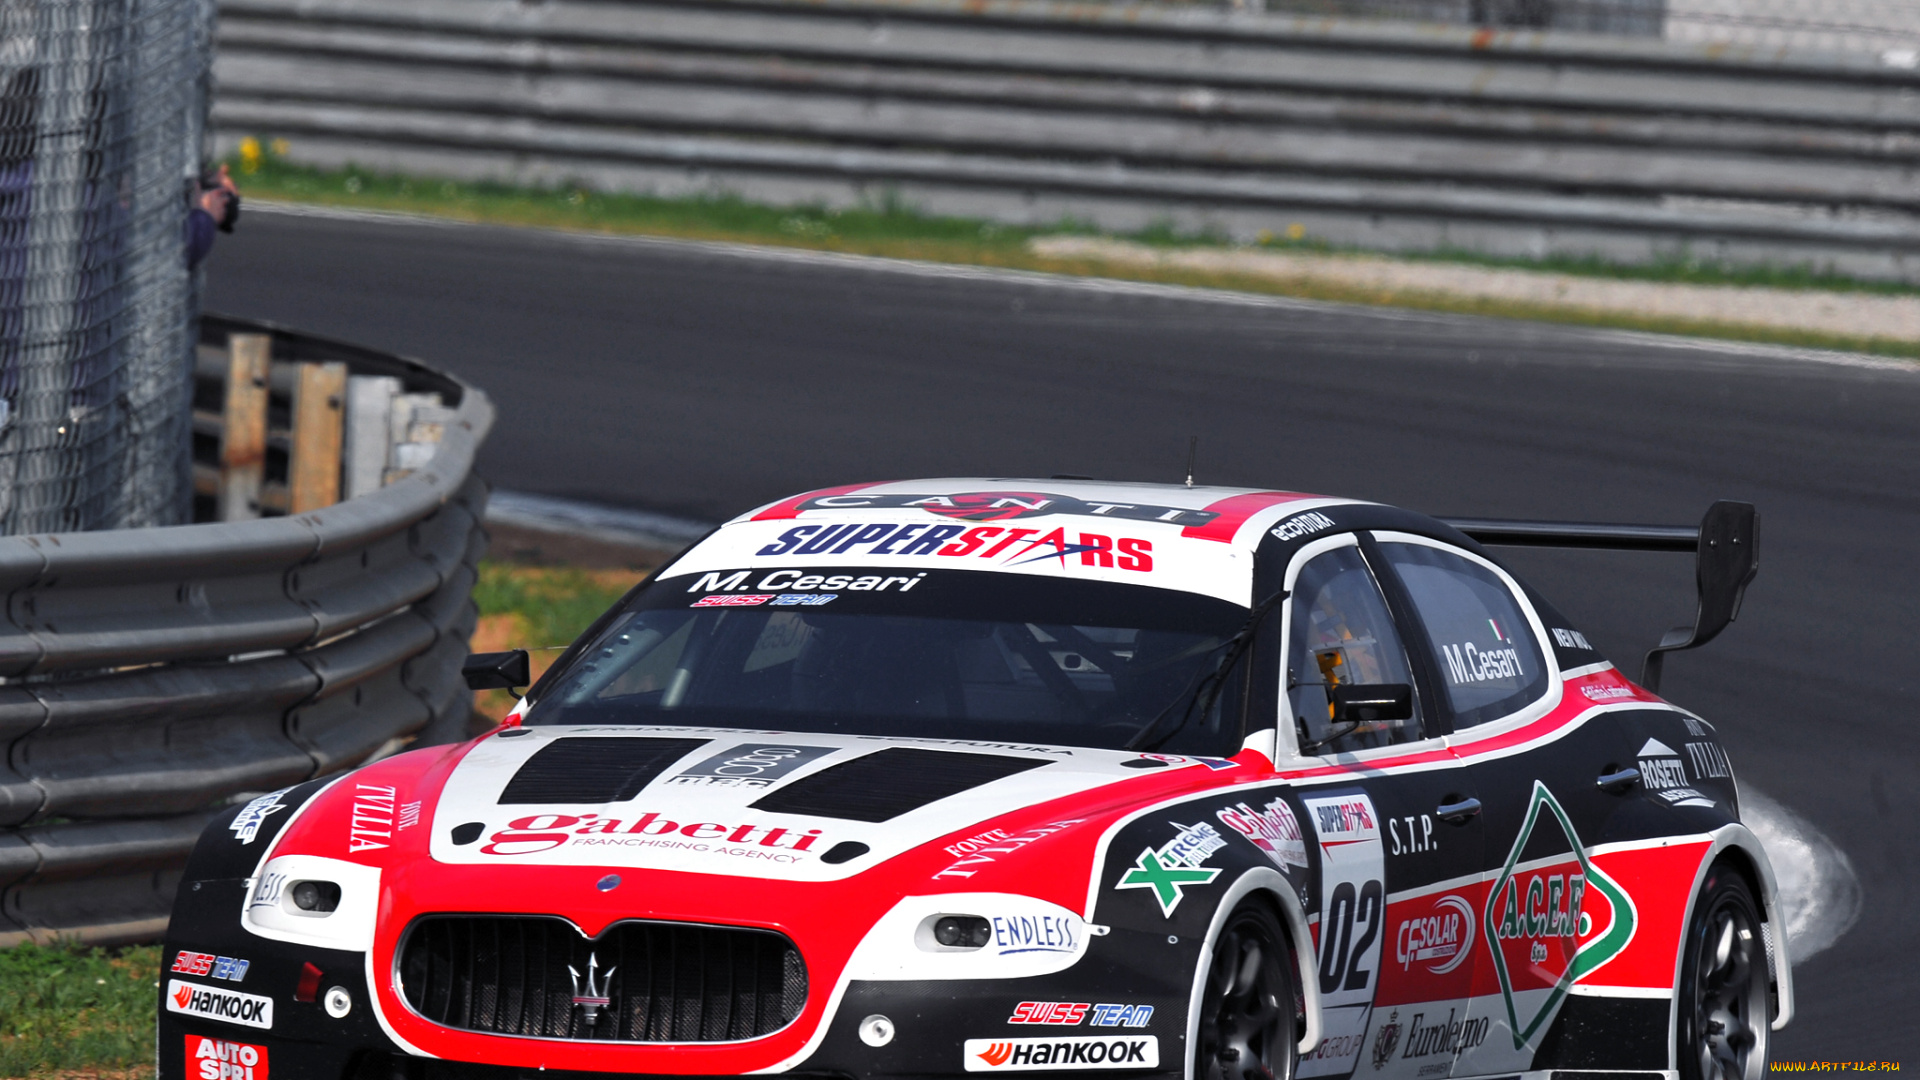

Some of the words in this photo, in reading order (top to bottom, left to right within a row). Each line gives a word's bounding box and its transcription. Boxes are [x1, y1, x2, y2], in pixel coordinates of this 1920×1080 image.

[814, 494, 1190, 523] CANTI
[755, 523, 1154, 573] SUPERSTARS
[689, 594, 777, 608] SWISS
[768, 593, 839, 606] TEAM
[1638, 759, 1690, 789] ROSETTI
[349, 783, 396, 853] TVLLIA
[480, 812, 824, 856] gabetti
[1316, 800, 1374, 834] SUPERSTARS
[572, 837, 708, 853] FRANCHISING
[713, 846, 803, 865] AGENCY
[931, 818, 1088, 880] TVLLIA
[942, 828, 1014, 858] FONTE
[1389, 814, 1438, 856] S.T.P.
[1498, 873, 1592, 939] A.C.E.F.
[992, 916, 1073, 948] ENDLESS
[1318, 879, 1384, 995] 02
[1418, 913, 1460, 948] SOLAR
[170, 950, 216, 976] SWISS
[211, 955, 250, 982] TEAM
[1007, 1001, 1091, 1026] SWISS
[1090, 1003, 1154, 1028] TEAM
[1401, 1007, 1489, 1062] Eurolegno
[195, 1038, 259, 1067] AUTO
